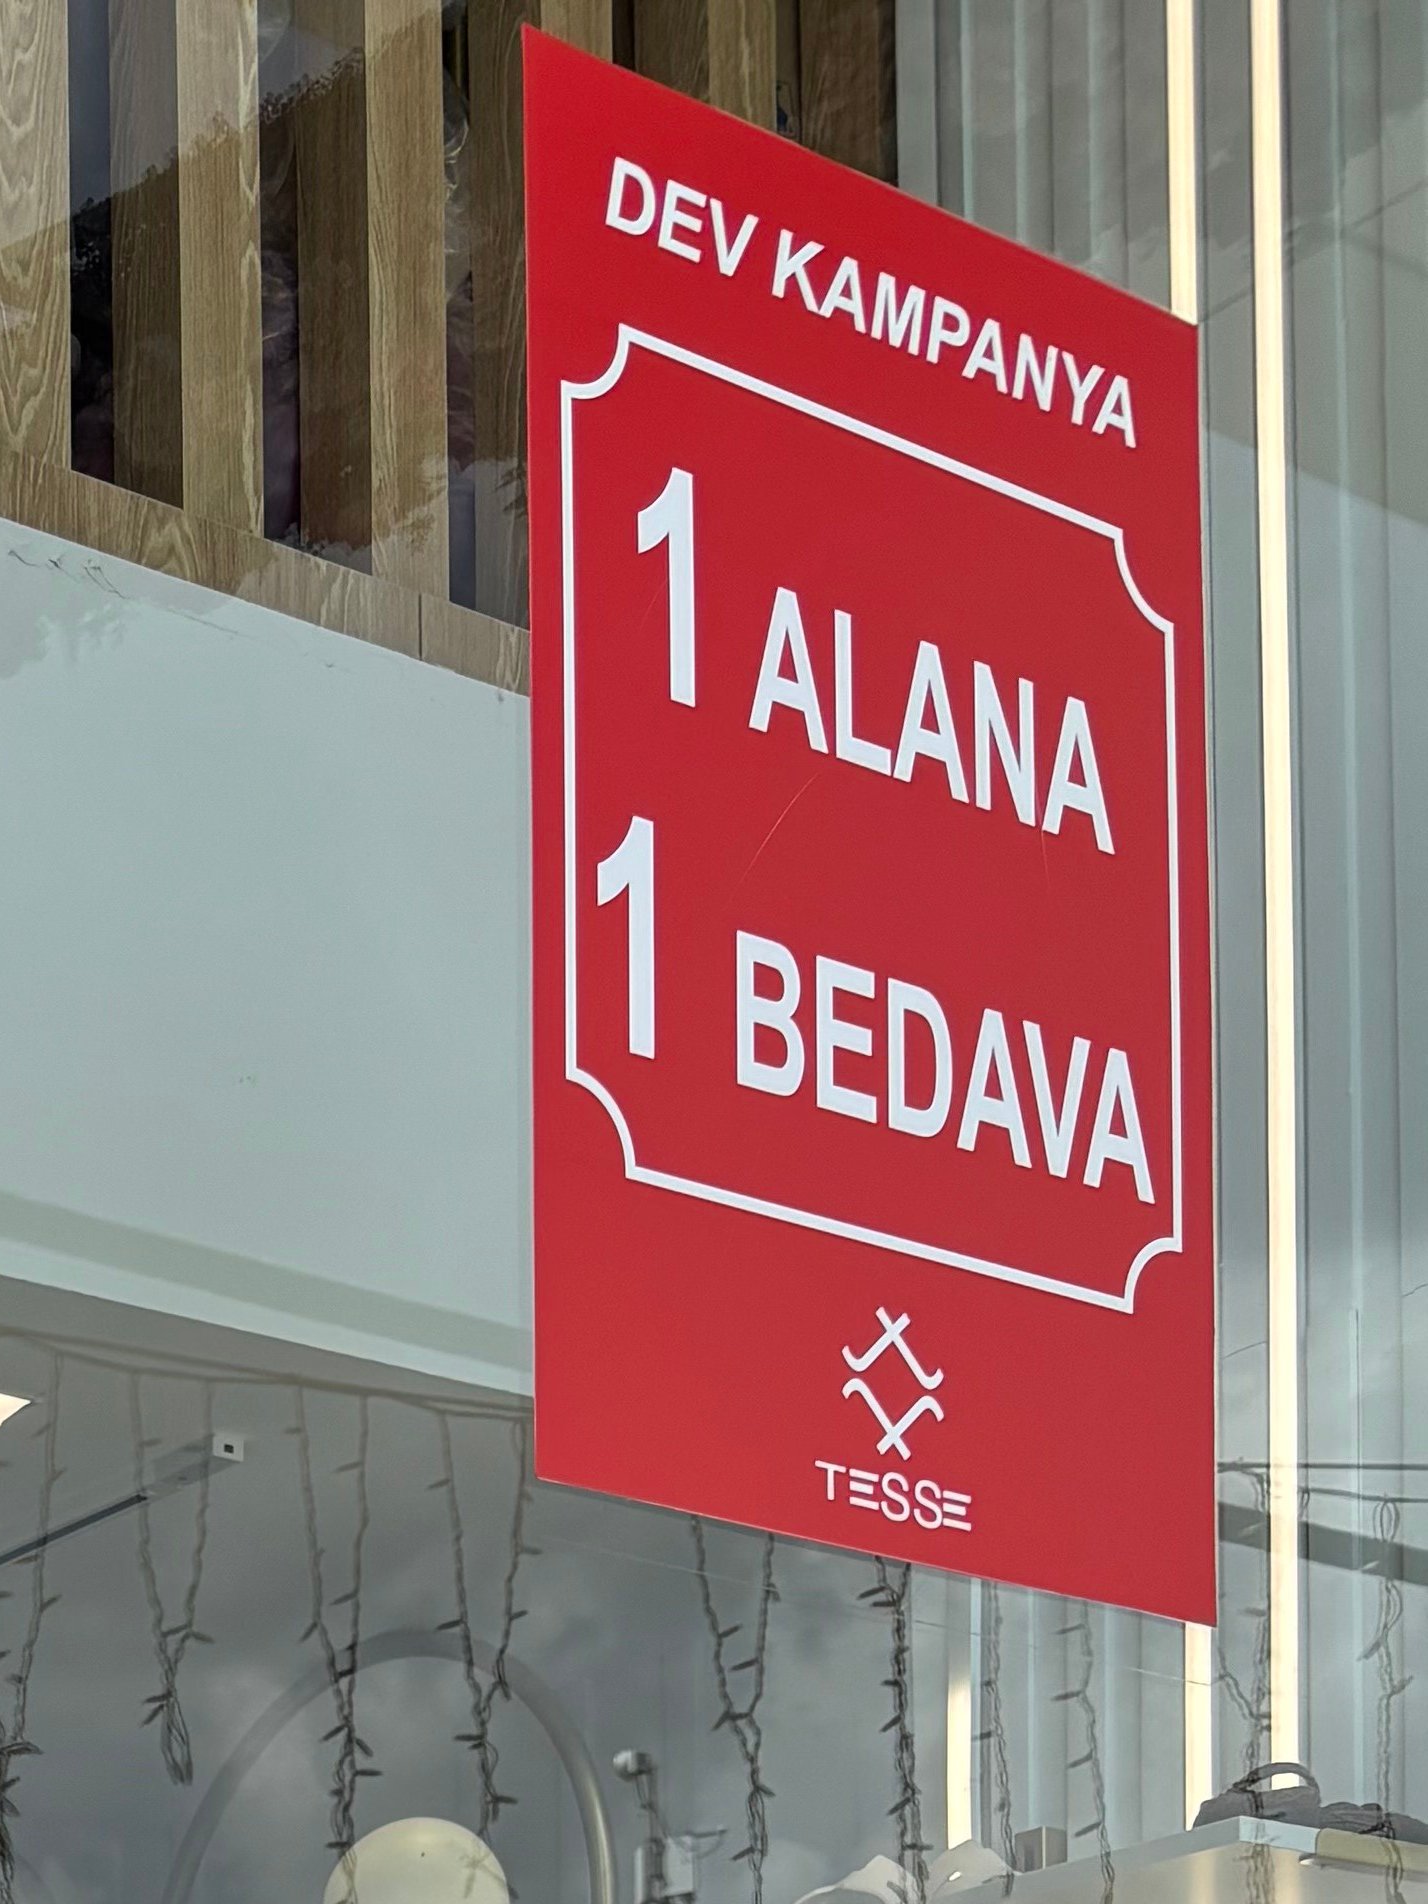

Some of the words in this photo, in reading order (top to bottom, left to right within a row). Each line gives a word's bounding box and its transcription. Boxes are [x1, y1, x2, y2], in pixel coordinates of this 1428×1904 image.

[605, 156, 759, 277] DEV
[772, 229, 1138, 448] KAMPANYA
[637, 467, 696, 708] 1
[748, 586, 1116, 855] ALANA
[597, 815, 655, 1060] 1
[736, 930, 1155, 1205] BEDAVA
[815, 1460, 972, 1532] TESSE
